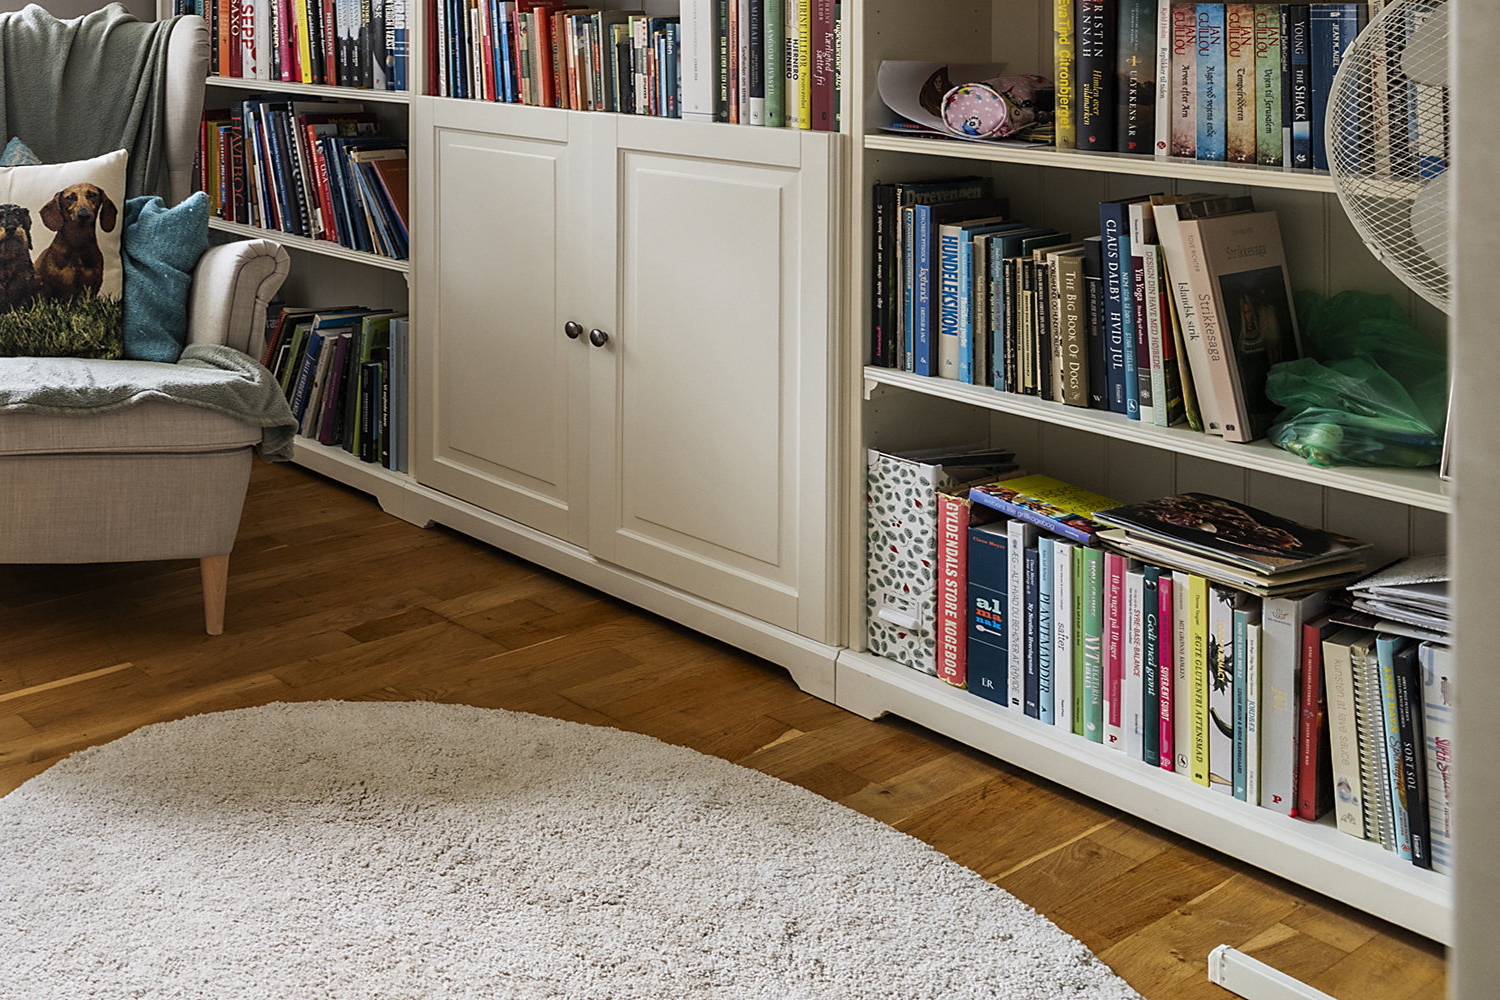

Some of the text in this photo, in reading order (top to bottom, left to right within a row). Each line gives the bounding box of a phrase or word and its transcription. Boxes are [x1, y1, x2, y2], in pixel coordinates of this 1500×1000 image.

[241, 4, 254, 50] SEPP
[666, 30, 674, 55] Italien
[1059, 19, 1071, 45] Tind
[1174, 11, 1186, 56] GUILLOU
[1184, 25, 1197, 45] JAN
[1198, 12, 1209, 57] GUILLOU
[1209, 25, 1221, 45] JAN
[1229, 12, 1241, 58] GUILLOU
[1240, 26, 1252, 46] JAN
[1256, 13, 1268, 59] GUILLOU
[1267, 26, 1279, 47] JAN
[1294, 21, 1304, 55] YOUNG
[799, 31, 807, 71] LILLEOR
[815, 50, 826, 86] sætter fri
[822, 31, 834, 72] Kærlighed
[1058, 50, 1072, 129] Citronbjerget
[905, 186, 982, 206] Dyrevennen
[941, 235, 958, 336] HUNDELEKSIKON
[1106, 219, 1123, 370] CLAUS DALBY HVID JUL
[1066, 271, 1080, 391] THE BIG BOOK OF DOGS
[1178, 282, 1199, 341] Islandsk strik
[1198, 294, 1221, 362] Strikkesaga
[944, 502, 959, 677] GYLDENDALS STORE KOGEBOG
[976, 596, 1002, 615] al
[975, 617, 1002, 631] nak
[976, 609, 1002, 623] ma
[1057, 622, 1069, 651] safter
[1145, 614, 1158, 696] Godt med grønt
[1384, 665, 1396, 701] ANNE
[1403, 741, 1416, 790] SORT SOL
